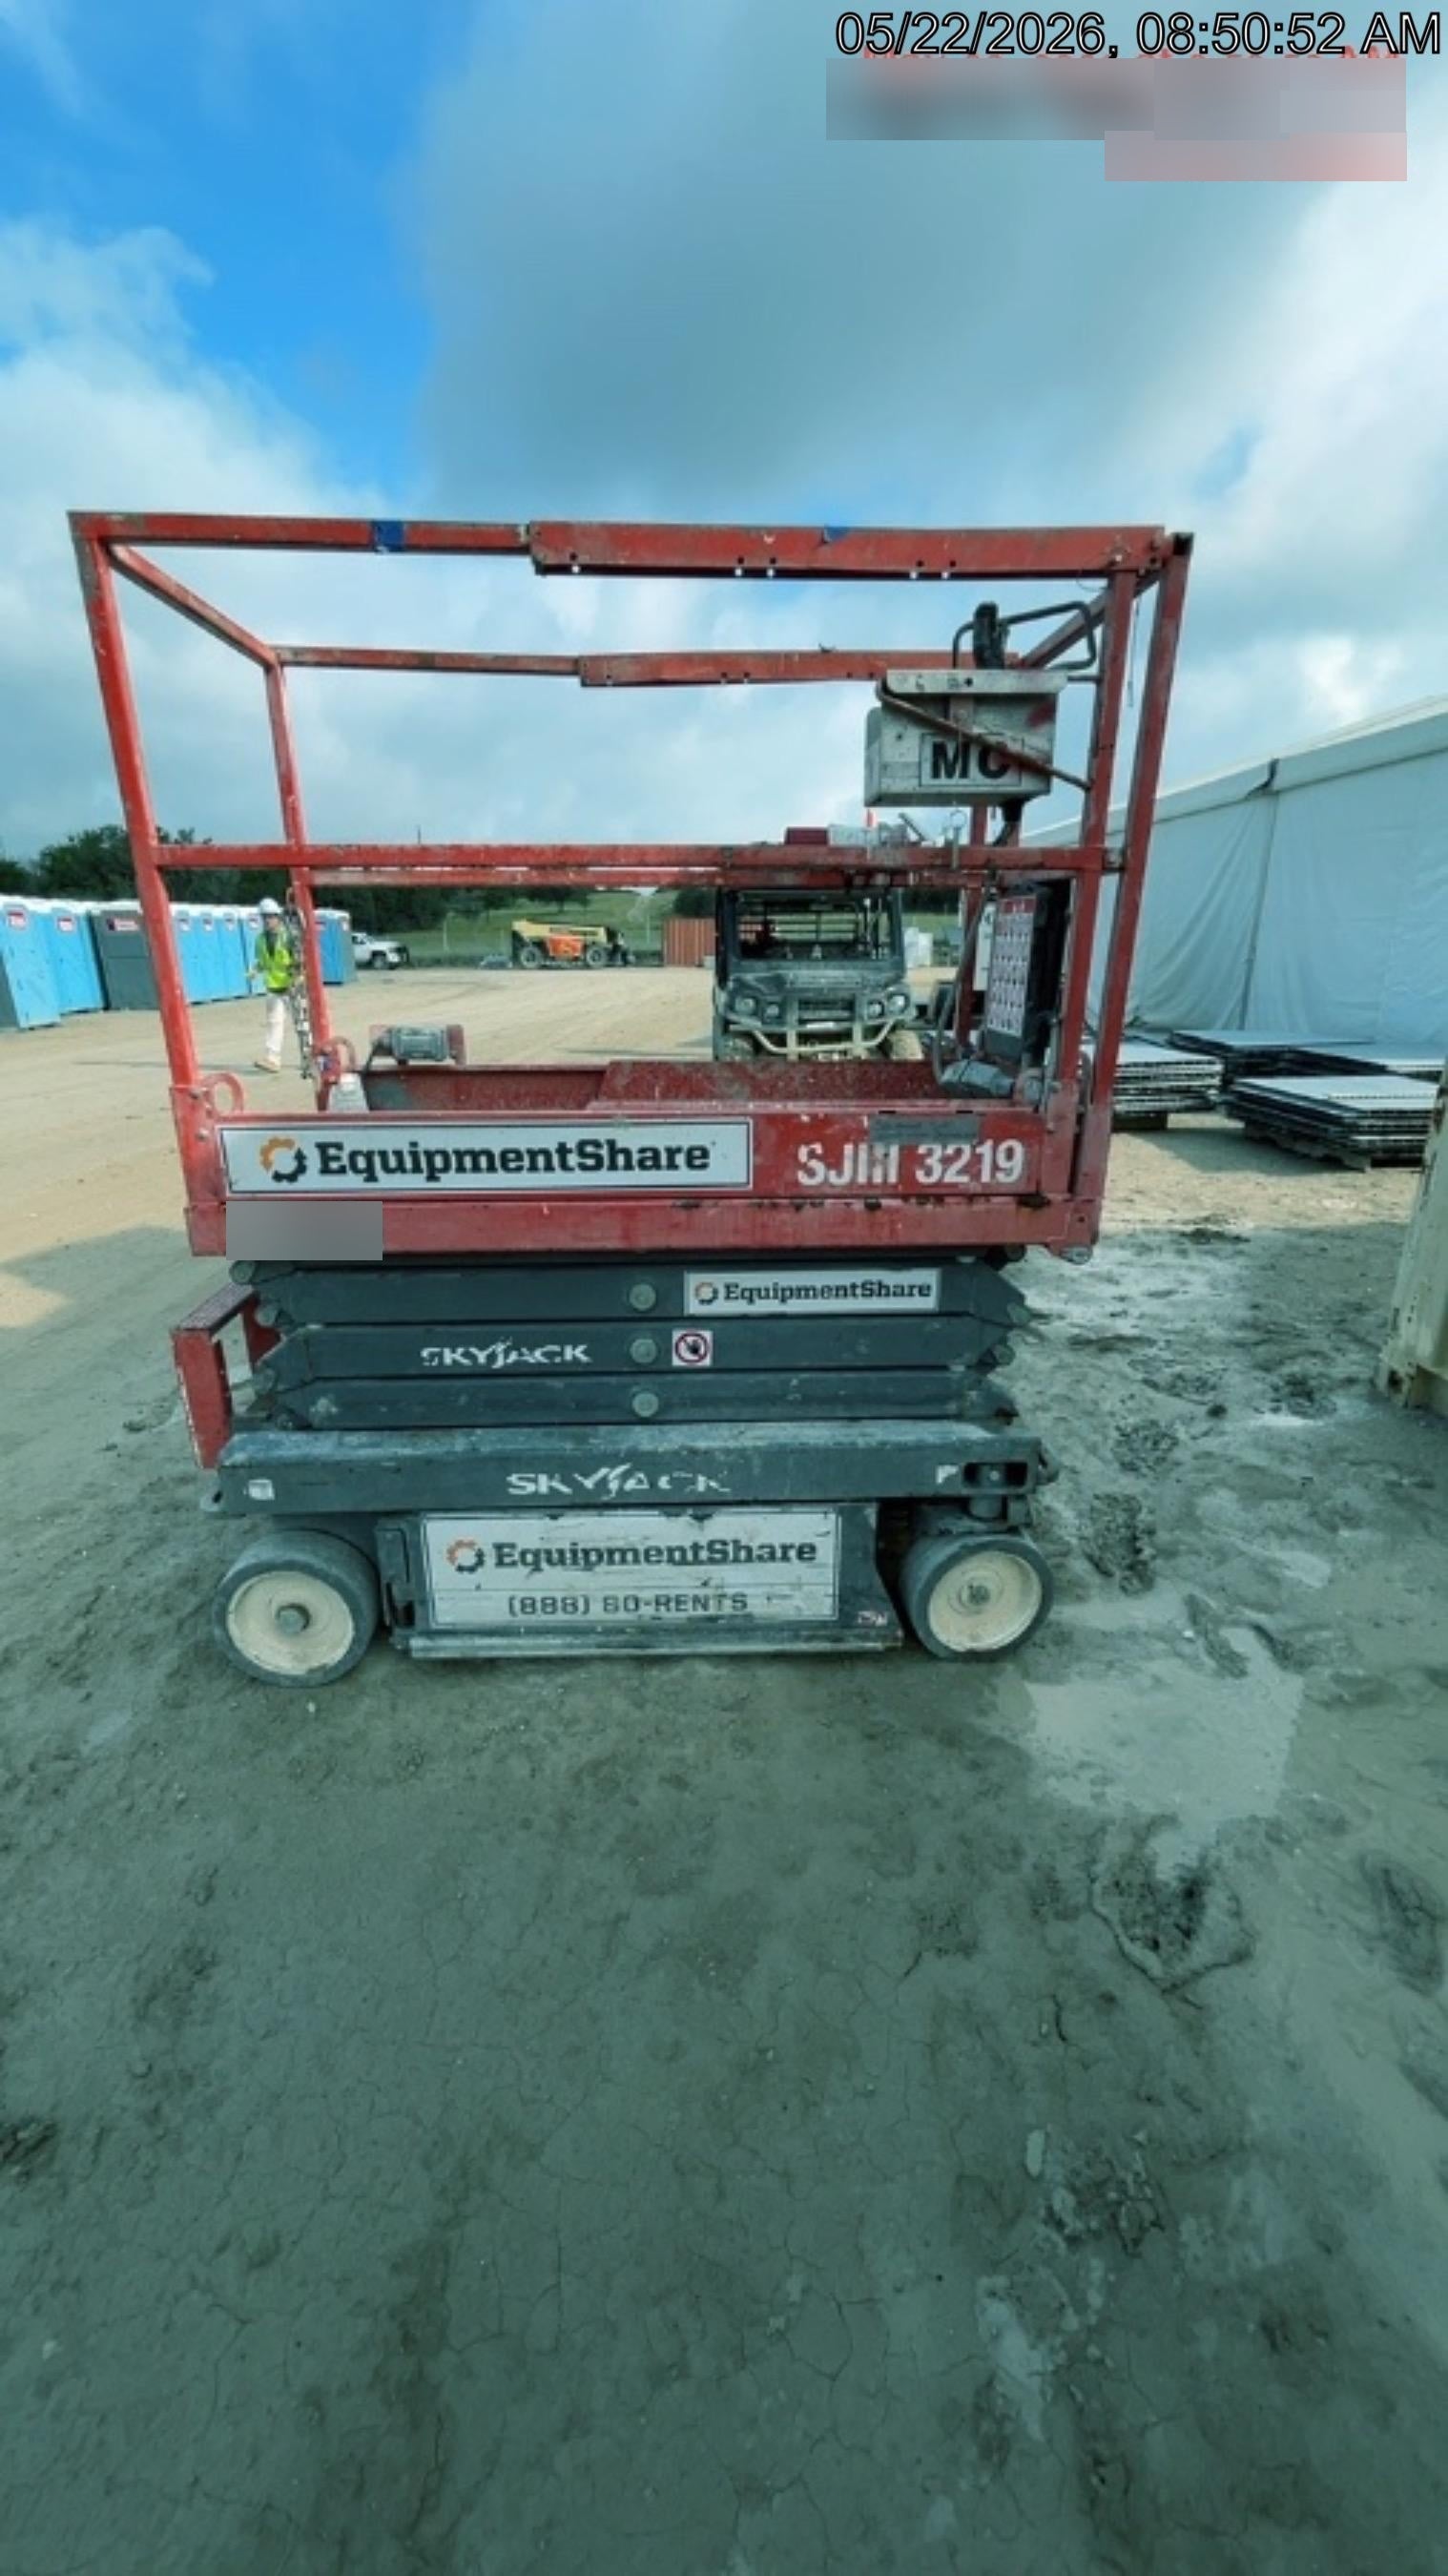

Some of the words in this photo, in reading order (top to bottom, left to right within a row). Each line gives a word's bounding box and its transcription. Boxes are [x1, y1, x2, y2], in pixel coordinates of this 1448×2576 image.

[315, 1138, 711, 1183] EquipmentShare
[915, 1138, 1025, 1185] 3219
[723, 1278, 932, 1305] EquipmentShare
[420, 1336, 593, 1369] SKYJACK
[492, 1537, 817, 1571] EquipmentShare
[507, 1593, 591, 1617] (888)
